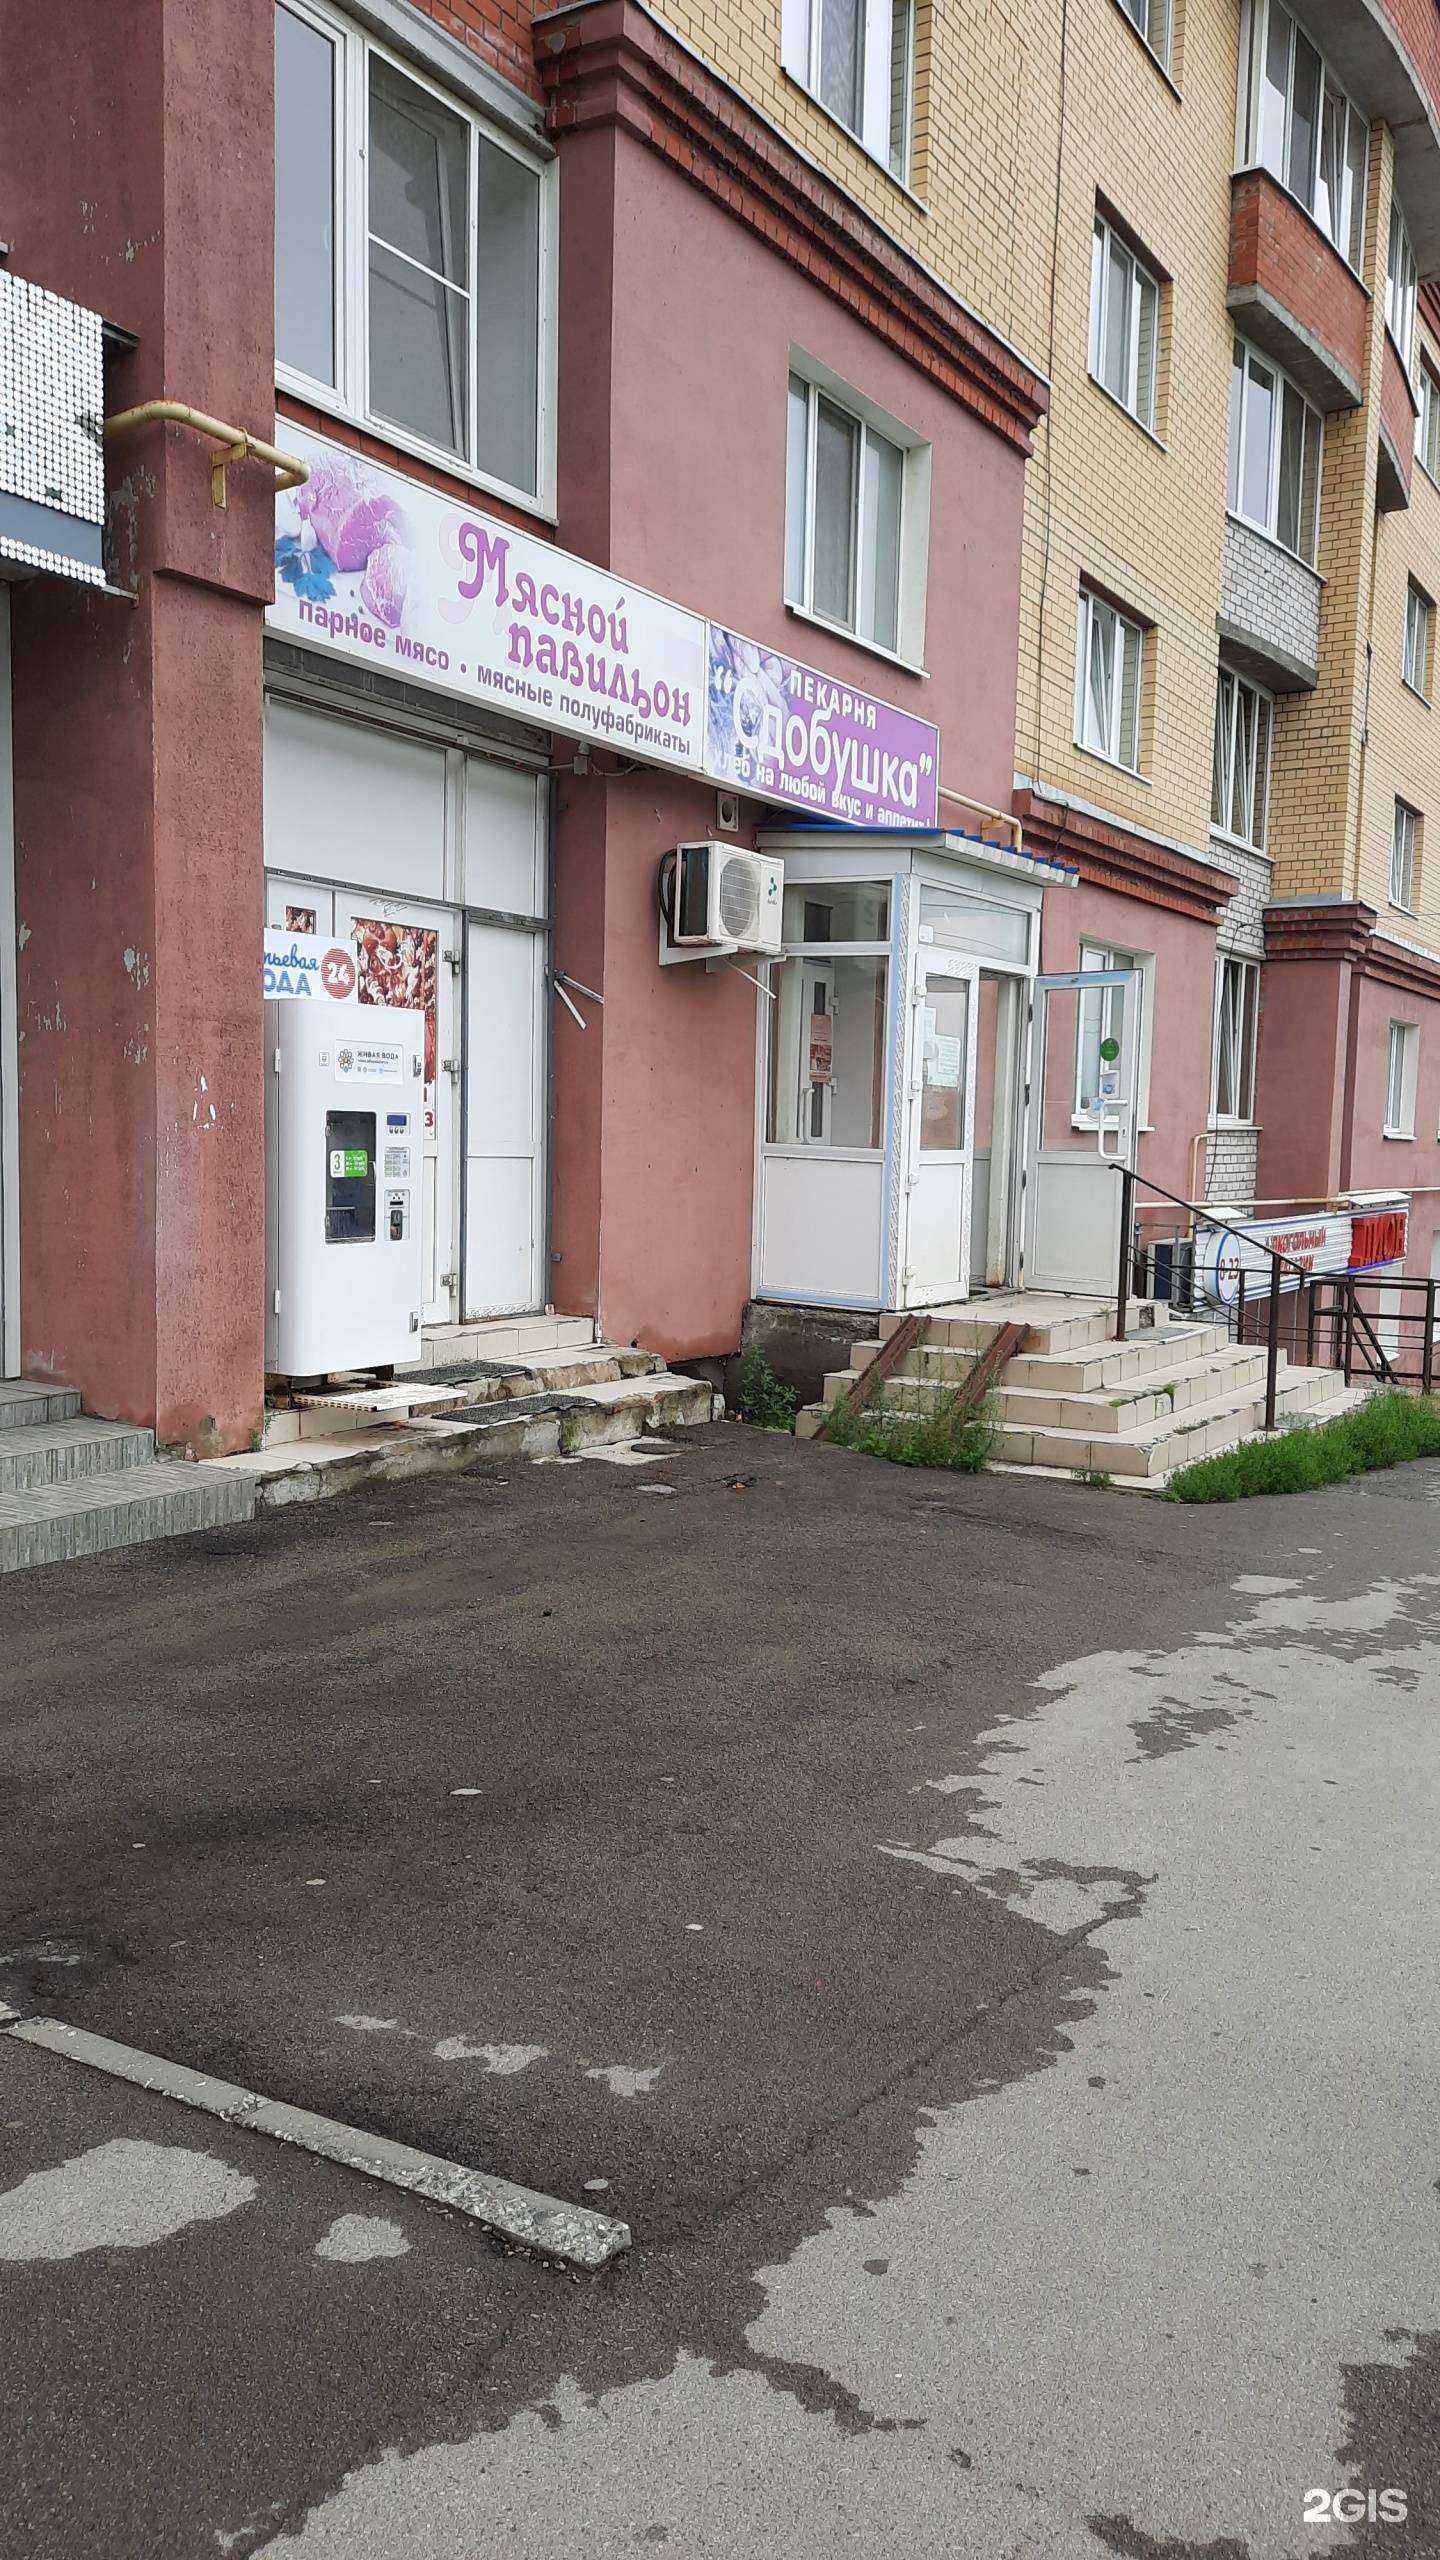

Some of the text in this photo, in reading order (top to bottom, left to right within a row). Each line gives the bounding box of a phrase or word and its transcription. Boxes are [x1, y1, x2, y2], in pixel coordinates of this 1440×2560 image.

[458, 521, 630, 655] Мясной
[298, 600, 691, 755] парное мясо мясные полуфабрикаты
[507, 621, 691, 727] павильон
[789, 668, 877, 730] ПЕКАРНЯ
[756, 763, 775, 787] на
[779, 772, 826, 803] любой
[832, 792, 862, 818] вкус
[865, 802, 874, 820] и
[381, 1051, 399, 1060] ВОДА
